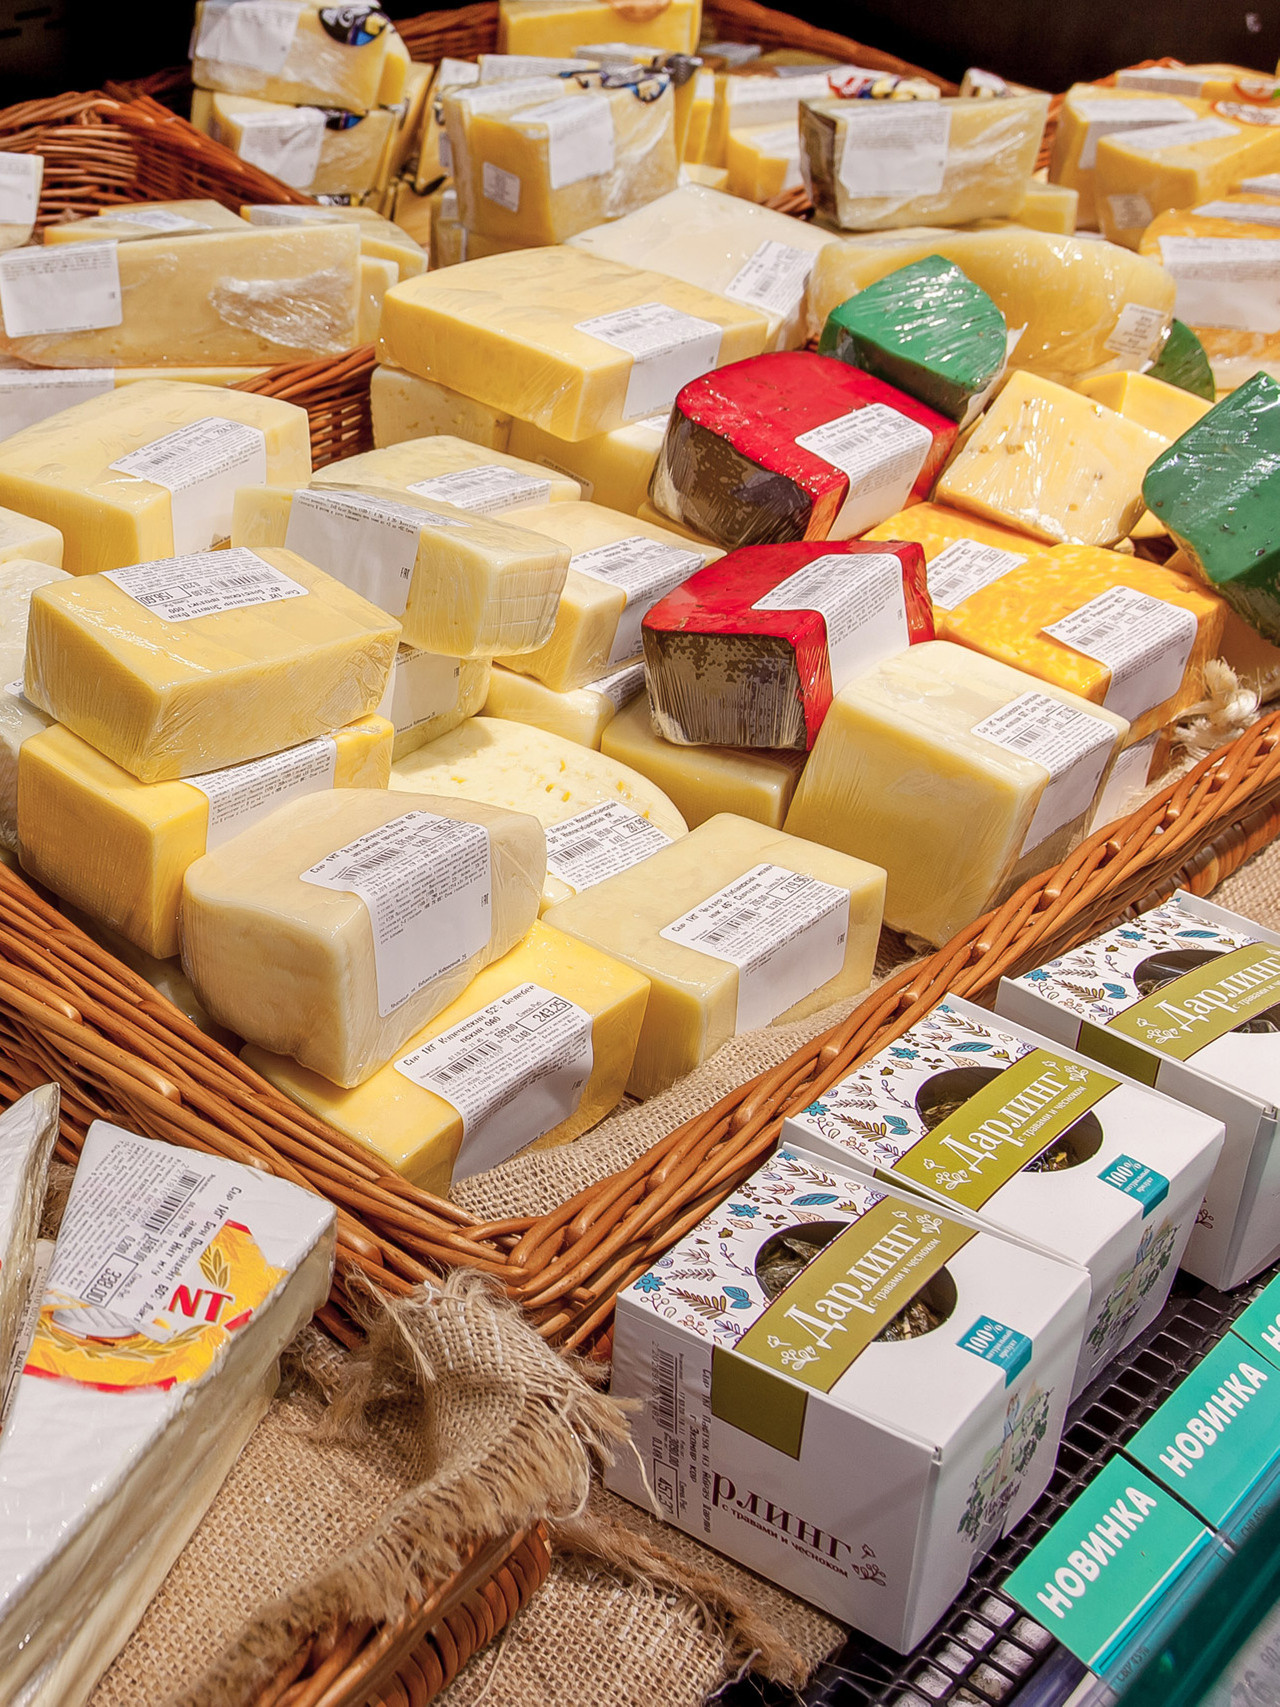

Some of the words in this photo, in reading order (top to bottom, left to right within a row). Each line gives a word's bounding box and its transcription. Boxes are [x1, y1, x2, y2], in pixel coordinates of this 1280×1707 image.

[530, 999, 568, 1023] 243.25
[402, 1053, 422, 1066] Сыр
[939, 1072, 1069, 1174] Дарлинг
[1103, 1154, 1144, 1190] 100%
[224, 1184, 242, 1203] Сыр
[84, 1264, 123, 1306] 338.00
[784, 1222, 923, 1350] Дарлинг
[960, 1317, 1008, 1358] 100%
[1159, 1361, 1268, 1478] НОВИНКА
[711, 1470, 853, 1562] рлинг
[731, 1507, 779, 1540] травами
[1036, 1485, 1158, 1620] НОВИНКА
